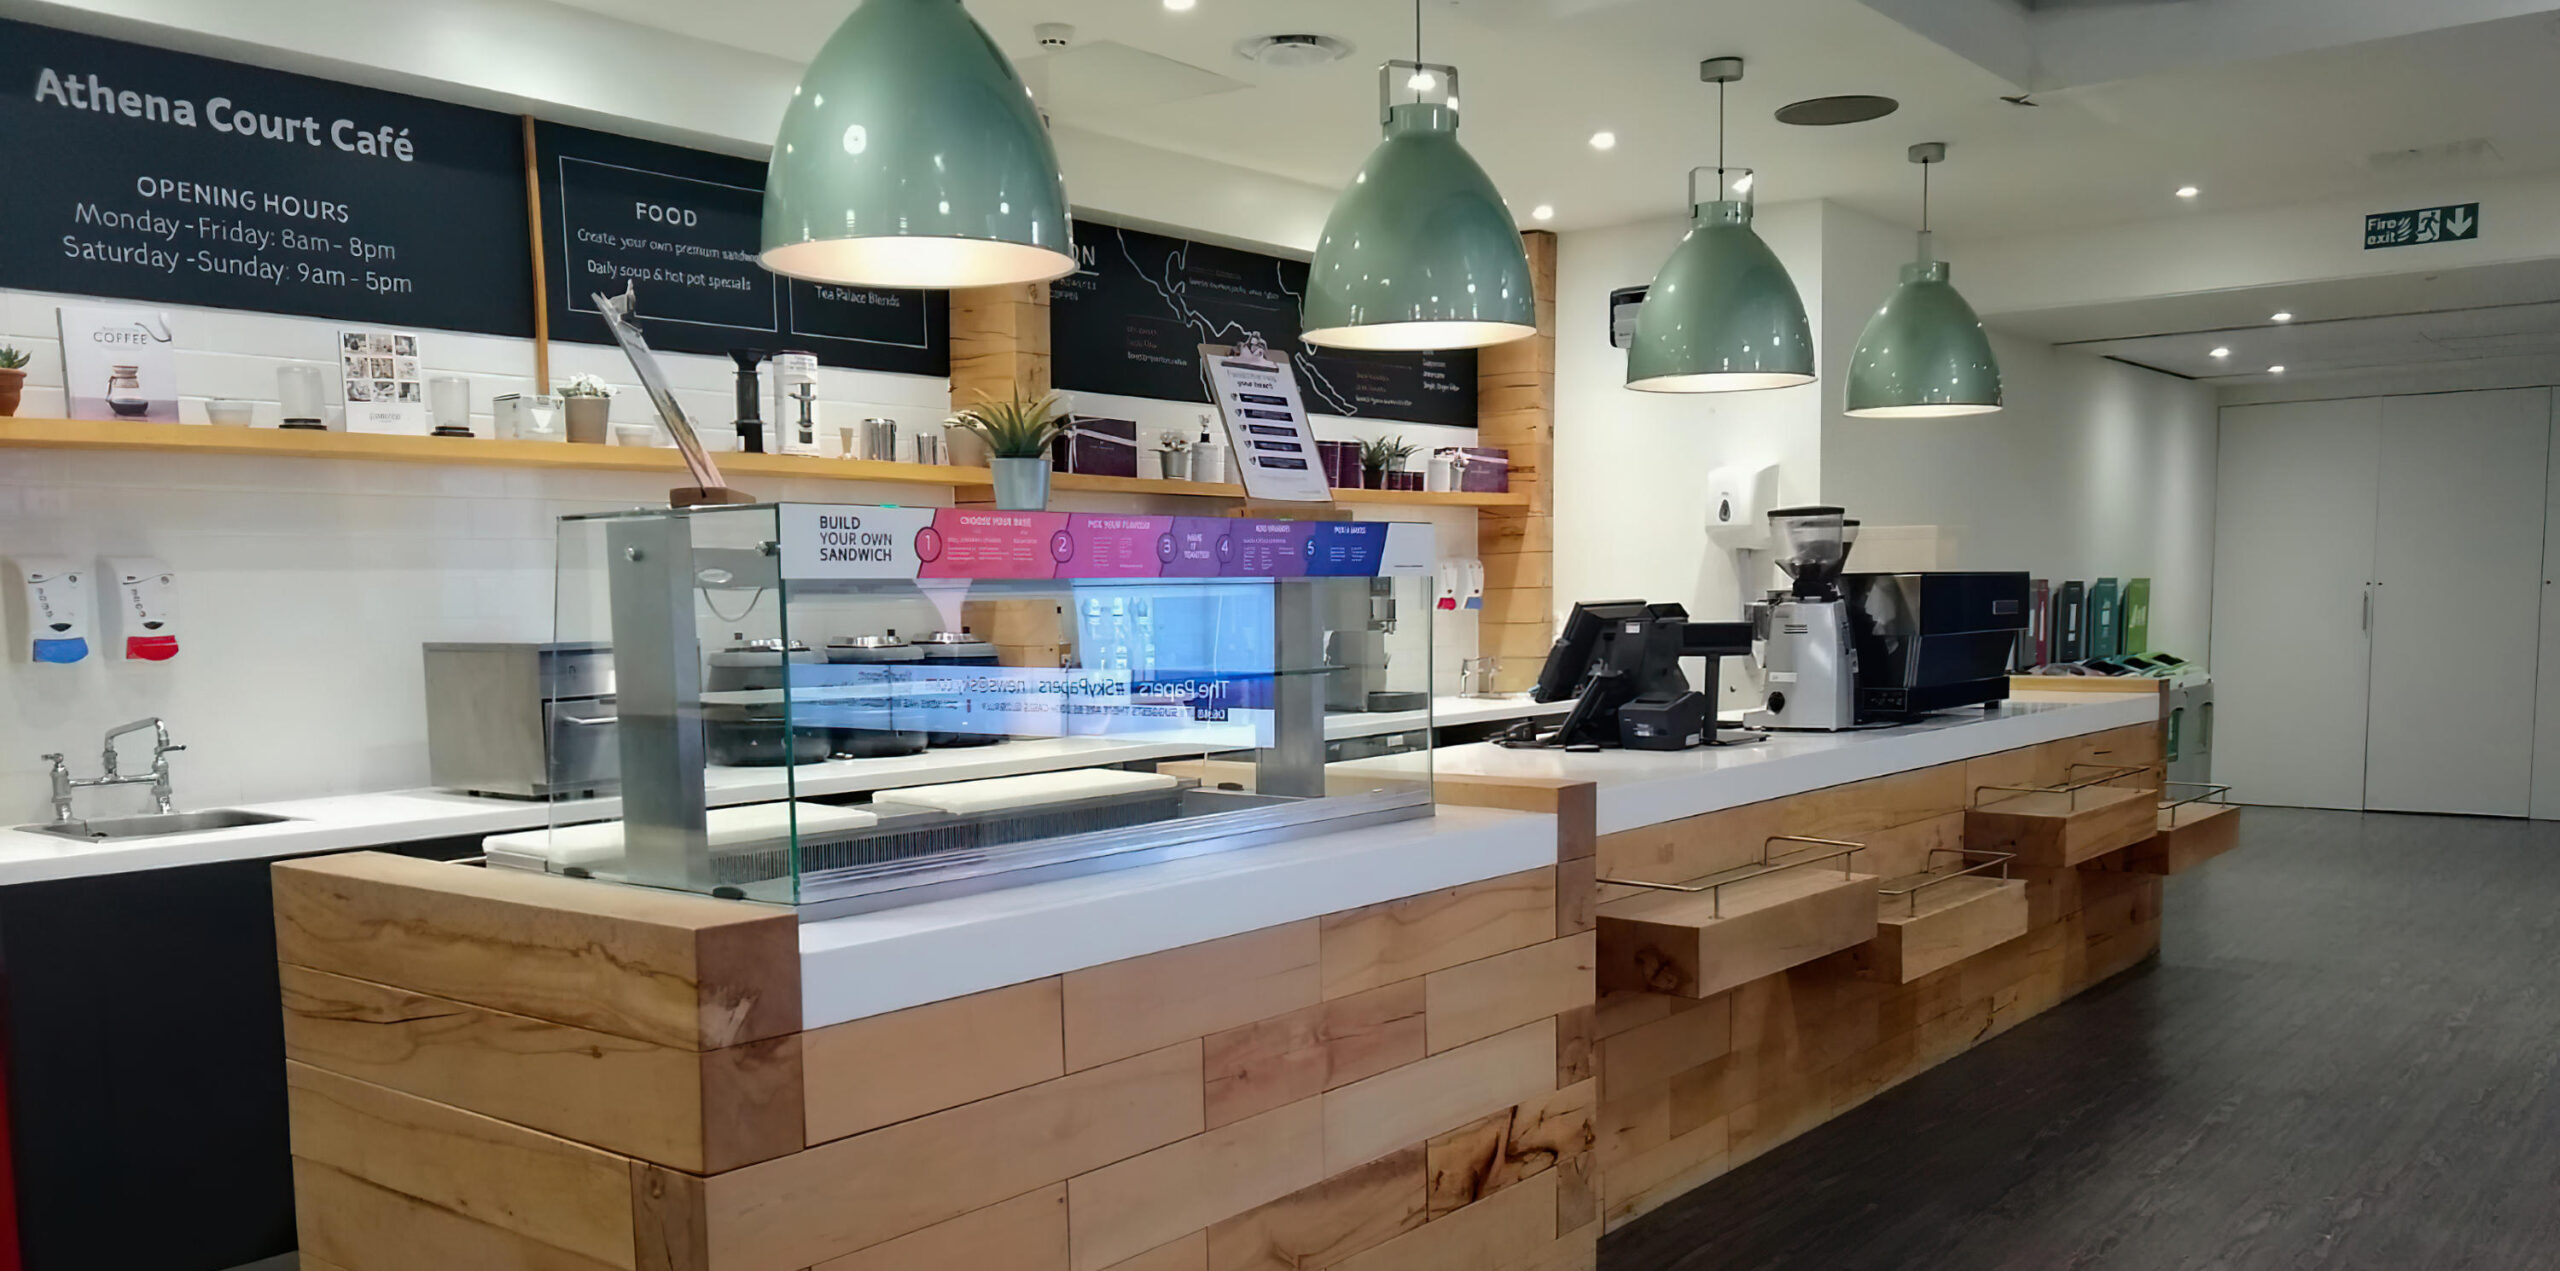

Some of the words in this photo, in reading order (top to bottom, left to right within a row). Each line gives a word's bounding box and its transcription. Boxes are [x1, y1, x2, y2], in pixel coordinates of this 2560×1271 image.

[35, 68, 197, 127] Athena
[206, 98, 321, 146] Court
[331, 118, 414, 162] Café
[137, 176, 256, 211] OPENING
[264, 193, 349, 224] HOURS
[636, 202, 697, 226] FOOD
[75, 203, 179, 241] Monday
[199, 218, 275, 251] Friday:
[282, 228, 329, 252] 8am
[350, 237, 395, 263] 8pm
[577, 228, 616, 246] Create
[620, 237, 646, 250] your
[650, 241, 673, 252] own
[675, 244, 719, 258] premium
[63, 236, 178, 274] Saturday
[198, 252, 289, 285] Sunday:
[298, 263, 345, 286] 9am
[366, 271, 411, 295] 5pm
[588, 259, 617, 279] Daily
[620, 266, 650, 280] soup
[654, 269, 662, 280] &
[665, 269, 684, 284] hot
[687, 274, 705, 286] pot
[708, 276, 751, 291] specials
[815, 285, 834, 300] Tea
[836, 287, 866, 304] Palace
[868, 291, 900, 307] Blends
[93, 331, 147, 345] COFFEE
[820, 516, 860, 529] BUILD
[820, 532, 856, 545] YOUR
[861, 533, 892, 545] OWN
[925, 535, 930, 551] 1
[1058, 536, 1067, 552] 2
[1164, 539, 1170, 553] 3
[820, 548, 892, 561] SANDWICH
[1221, 540, 1228, 554] 4
[1308, 540, 1314, 555] 5
